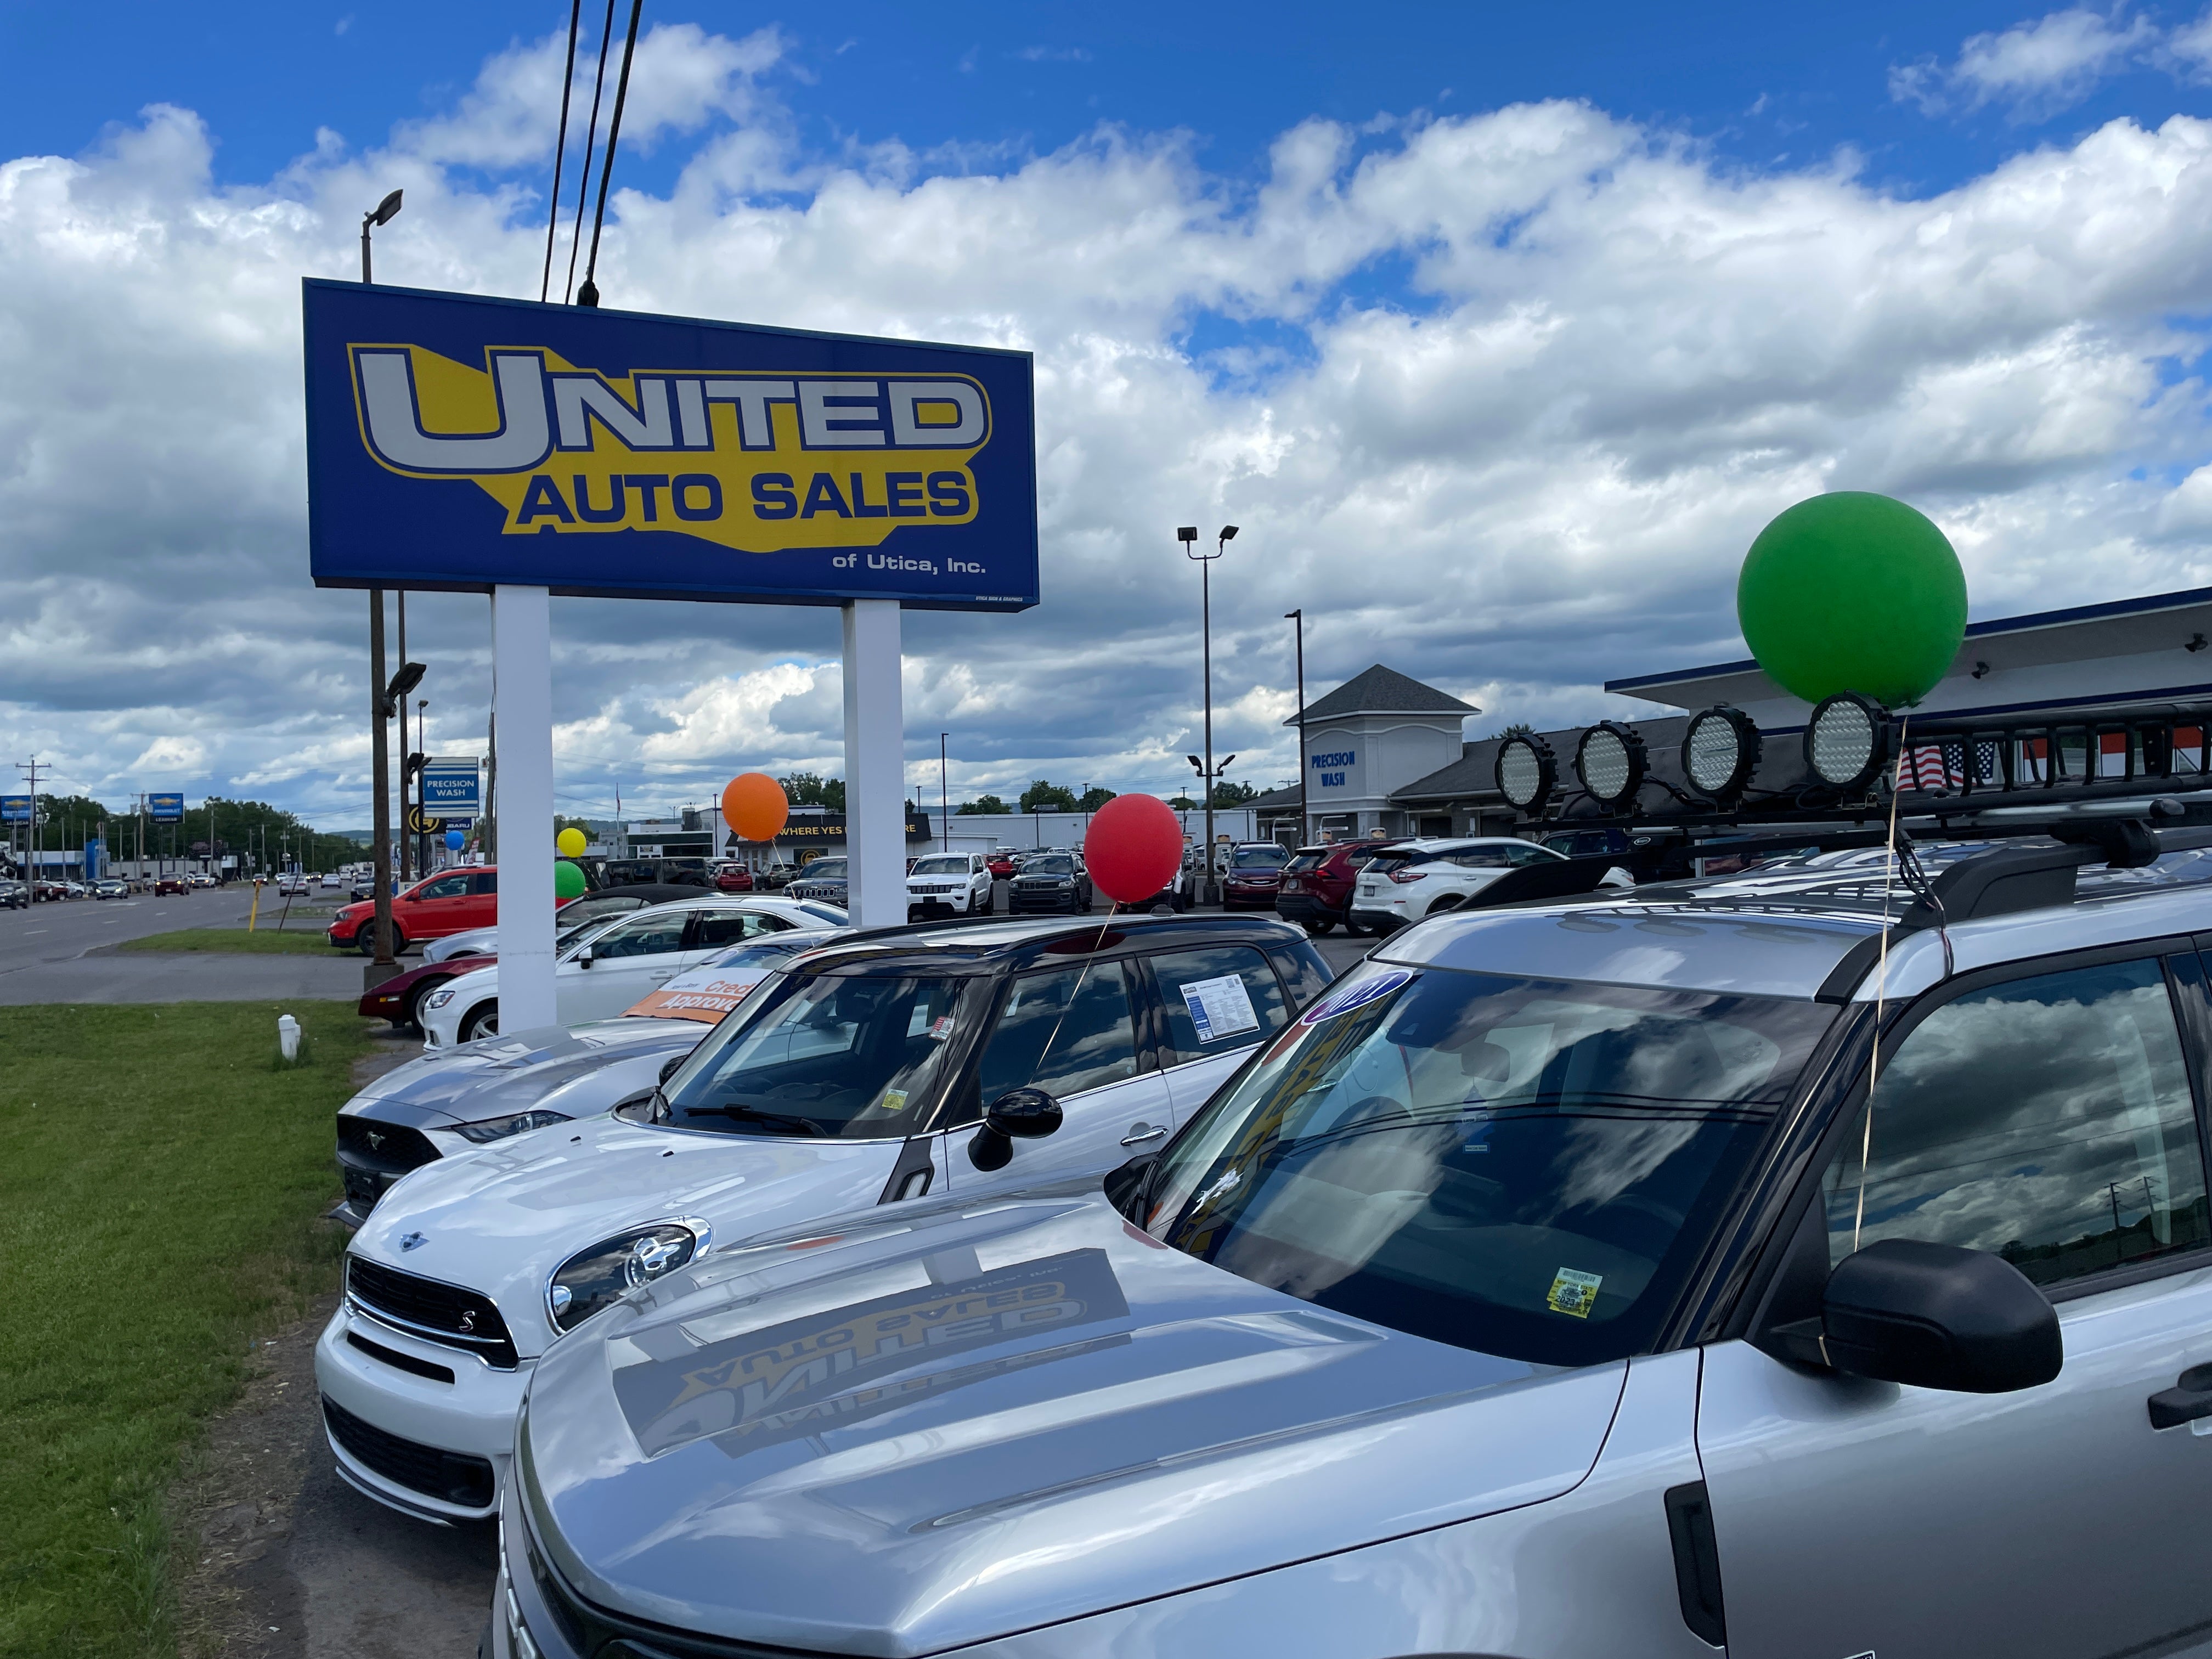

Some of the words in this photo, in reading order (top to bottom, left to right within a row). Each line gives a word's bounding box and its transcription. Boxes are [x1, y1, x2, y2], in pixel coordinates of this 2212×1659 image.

[359, 353, 985, 469] UNITED
[515, 473, 724, 524] AUTO
[752, 471, 971, 520] SALES
[832, 553, 857, 568] of
[867, 554, 938, 575] Utica,
[947, 557, 986, 573] Inc.
[1311, 751, 1355, 769] PRECISION
[1321, 772, 1345, 787] WASH
[779, 827, 820, 836] WHERE
[821, 826, 843, 835] YES
[1310, 973, 1401, 1021] 2021
[1556, 1295, 1576, 1306] 2023
[459, 1311, 476, 1332] S
